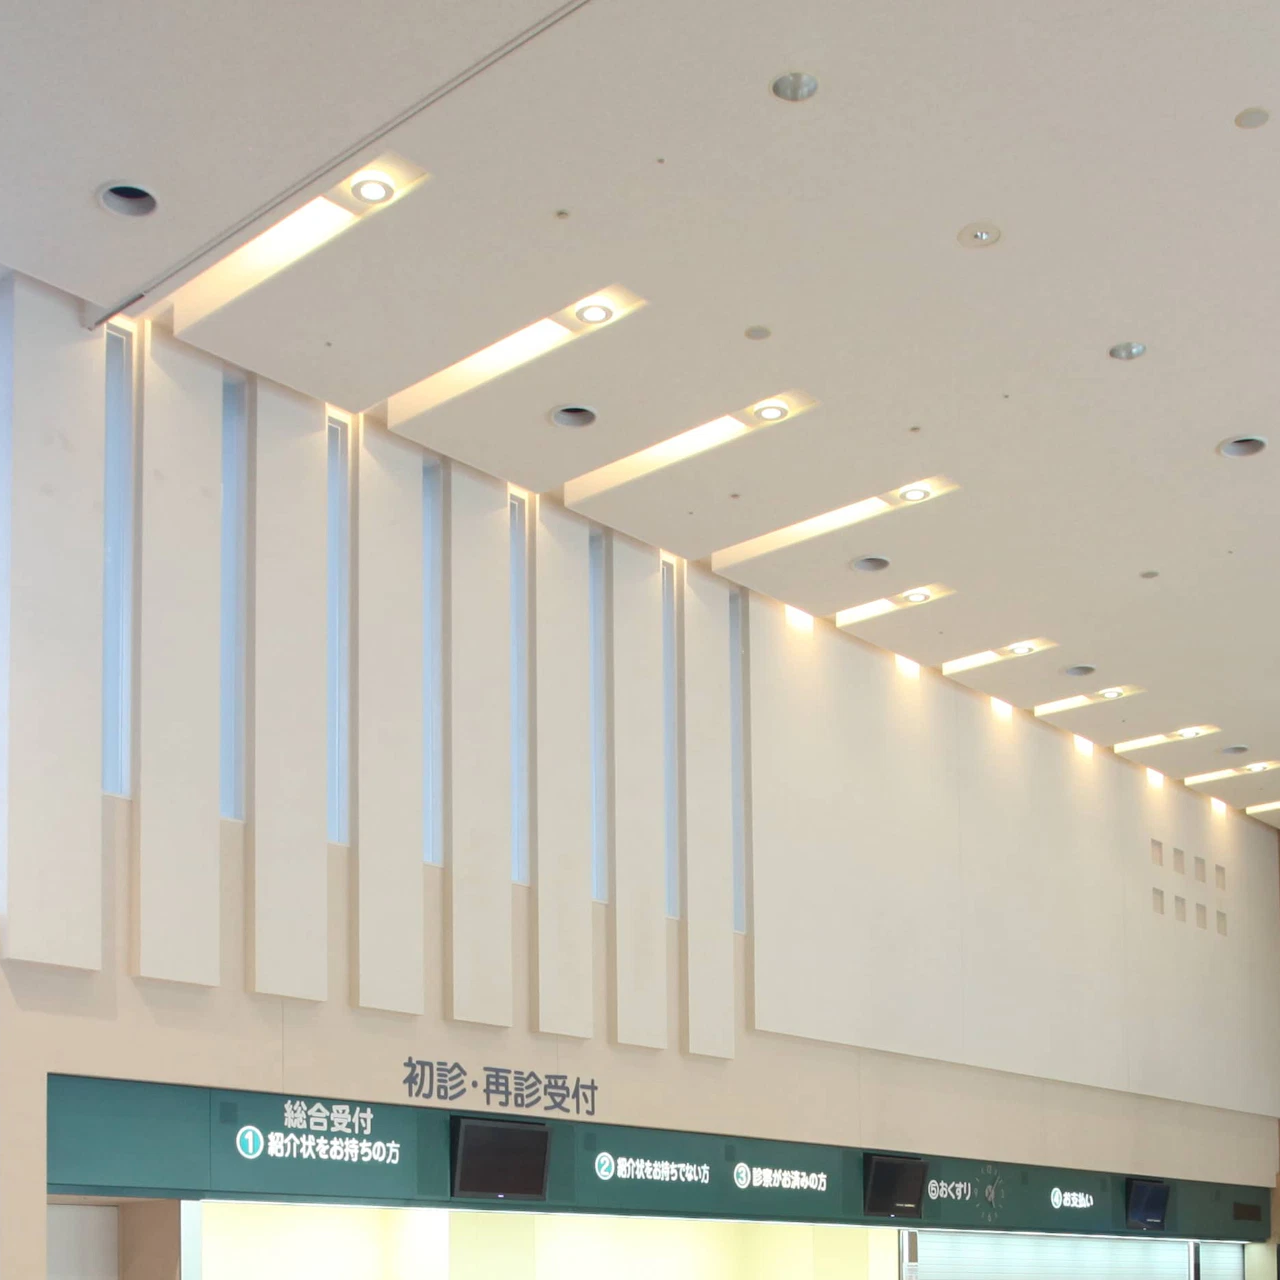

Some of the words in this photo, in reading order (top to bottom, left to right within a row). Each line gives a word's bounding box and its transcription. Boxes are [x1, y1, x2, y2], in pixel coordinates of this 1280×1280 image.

[403, 1057, 598, 1116] 初診・再診受付
[284, 1101, 374, 1135] 総合受付
